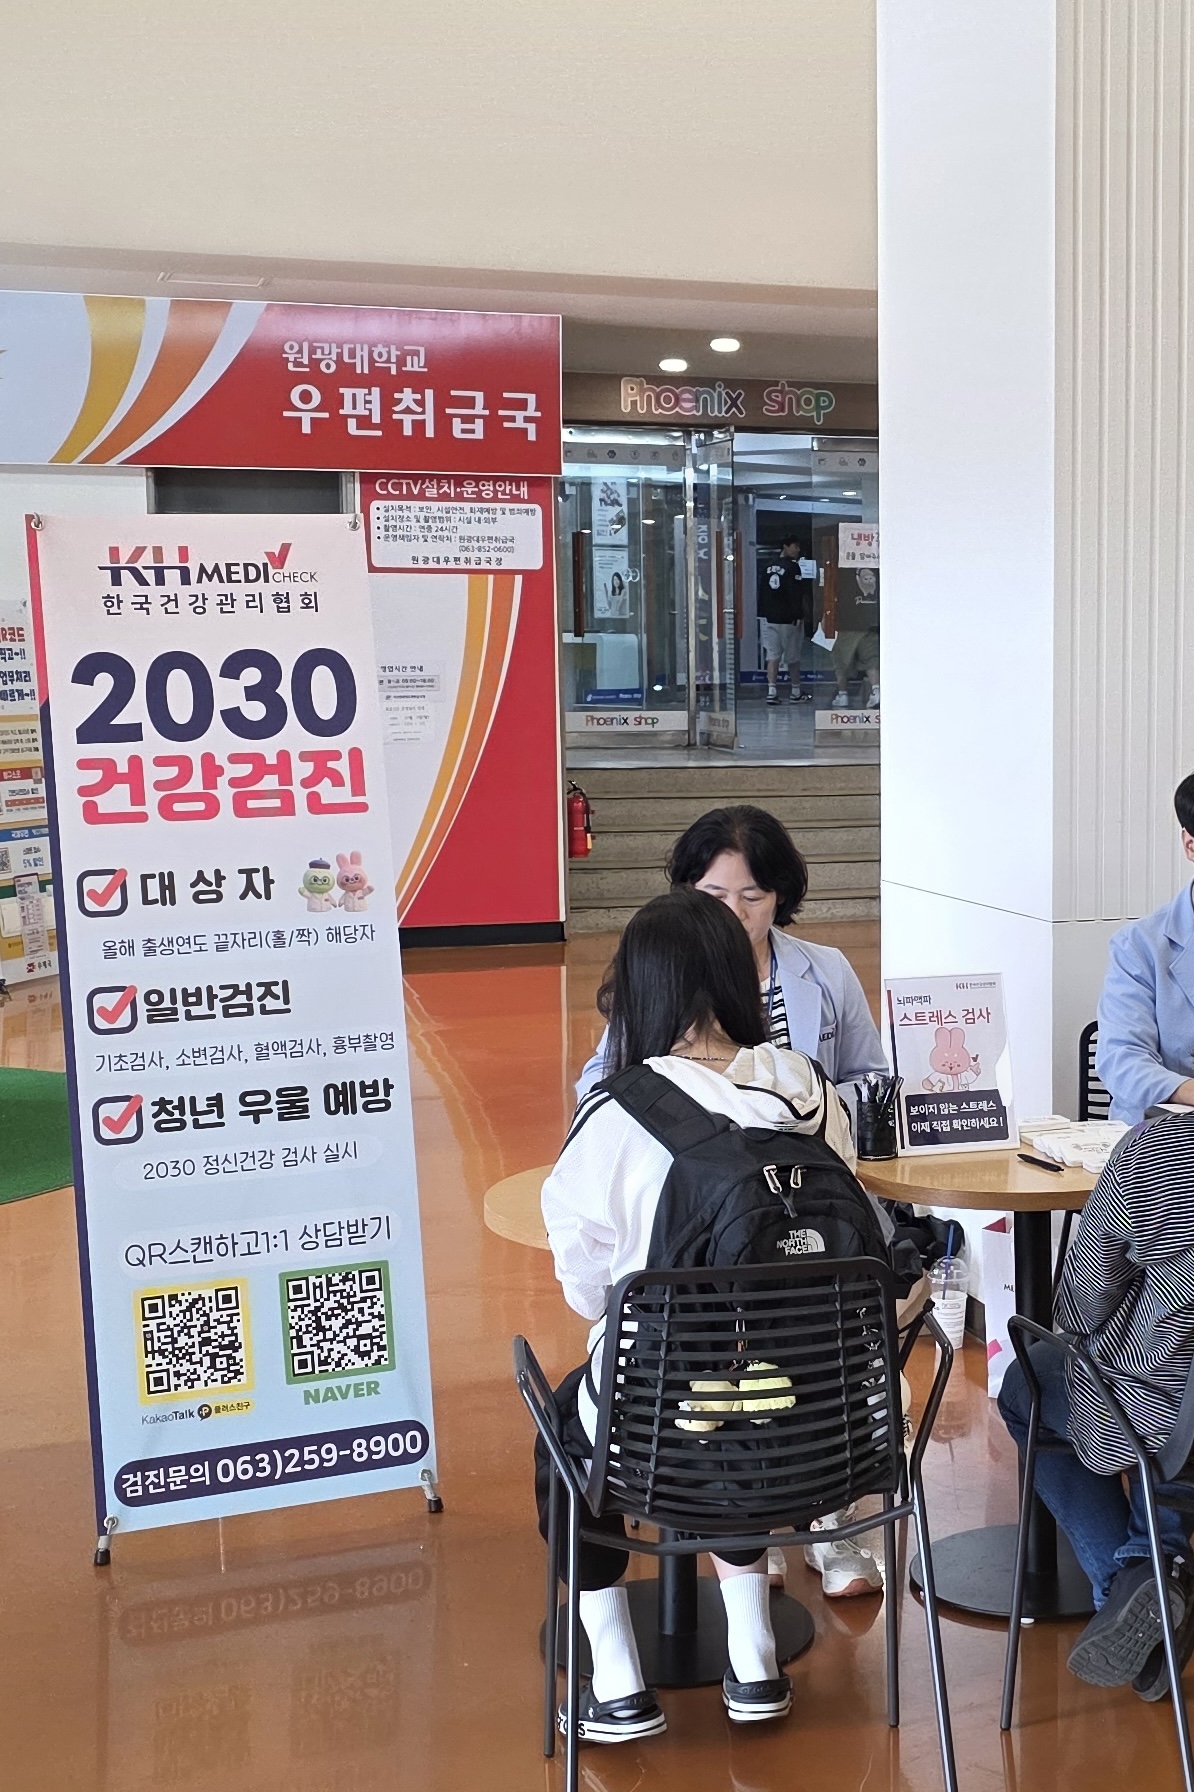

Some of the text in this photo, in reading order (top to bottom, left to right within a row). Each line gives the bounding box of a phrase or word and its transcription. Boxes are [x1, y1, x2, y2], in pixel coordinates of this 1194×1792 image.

[282, 340, 429, 375] 원광대학교
[282, 384, 542, 441] 우편취급국
[620, 377, 836, 425] Phoenix shop
[97, 545, 192, 587] KH
[271, 571, 319, 583] CHECK
[101, 591, 319, 616] 한국건강관리협회
[0, 626, 26, 643] R코드
[70, 647, 357, 745] 2030
[585, 714, 659, 728] Phoenix shop
[830, 713, 871, 725] Phoenix
[76, 746, 369, 826] 건강검진
[102, 939, 135, 960] 올해
[141, 933, 209, 958] 출생연도
[325, 923, 376, 945] 해당자
[143, 979, 292, 1025] 일반검진
[899, 1006, 991, 1027] 스트레스 검사
[95, 1031, 395, 1074] 기초검사, 소변검사, 혈액검사, 흉부촬영
[150, 1077, 395, 1133] 청년 우울 예방
[910, 1103, 938, 1116] 보이지
[939, 1102, 958, 1115] 않는
[960, 1100, 997, 1112] 스트레스
[911, 1121, 930, 1134] 이제
[931, 1120, 950, 1132] 직접
[143, 1140, 358, 1181] 2030 정신건강 검사 실시
[298, 1215, 391, 1251] 상담받기
[776, 1237, 807, 1249] NORTH
[784, 1245, 808, 1256] FACE
[788, 1229, 806, 1239] THE
[303, 1380, 381, 1406] NAVER
[141, 1408, 195, 1426] KakaoTalk
[214, 1401, 251, 1415] 플러스친구
[120, 1430, 423, 1499] 검진문의 063)259-8900
